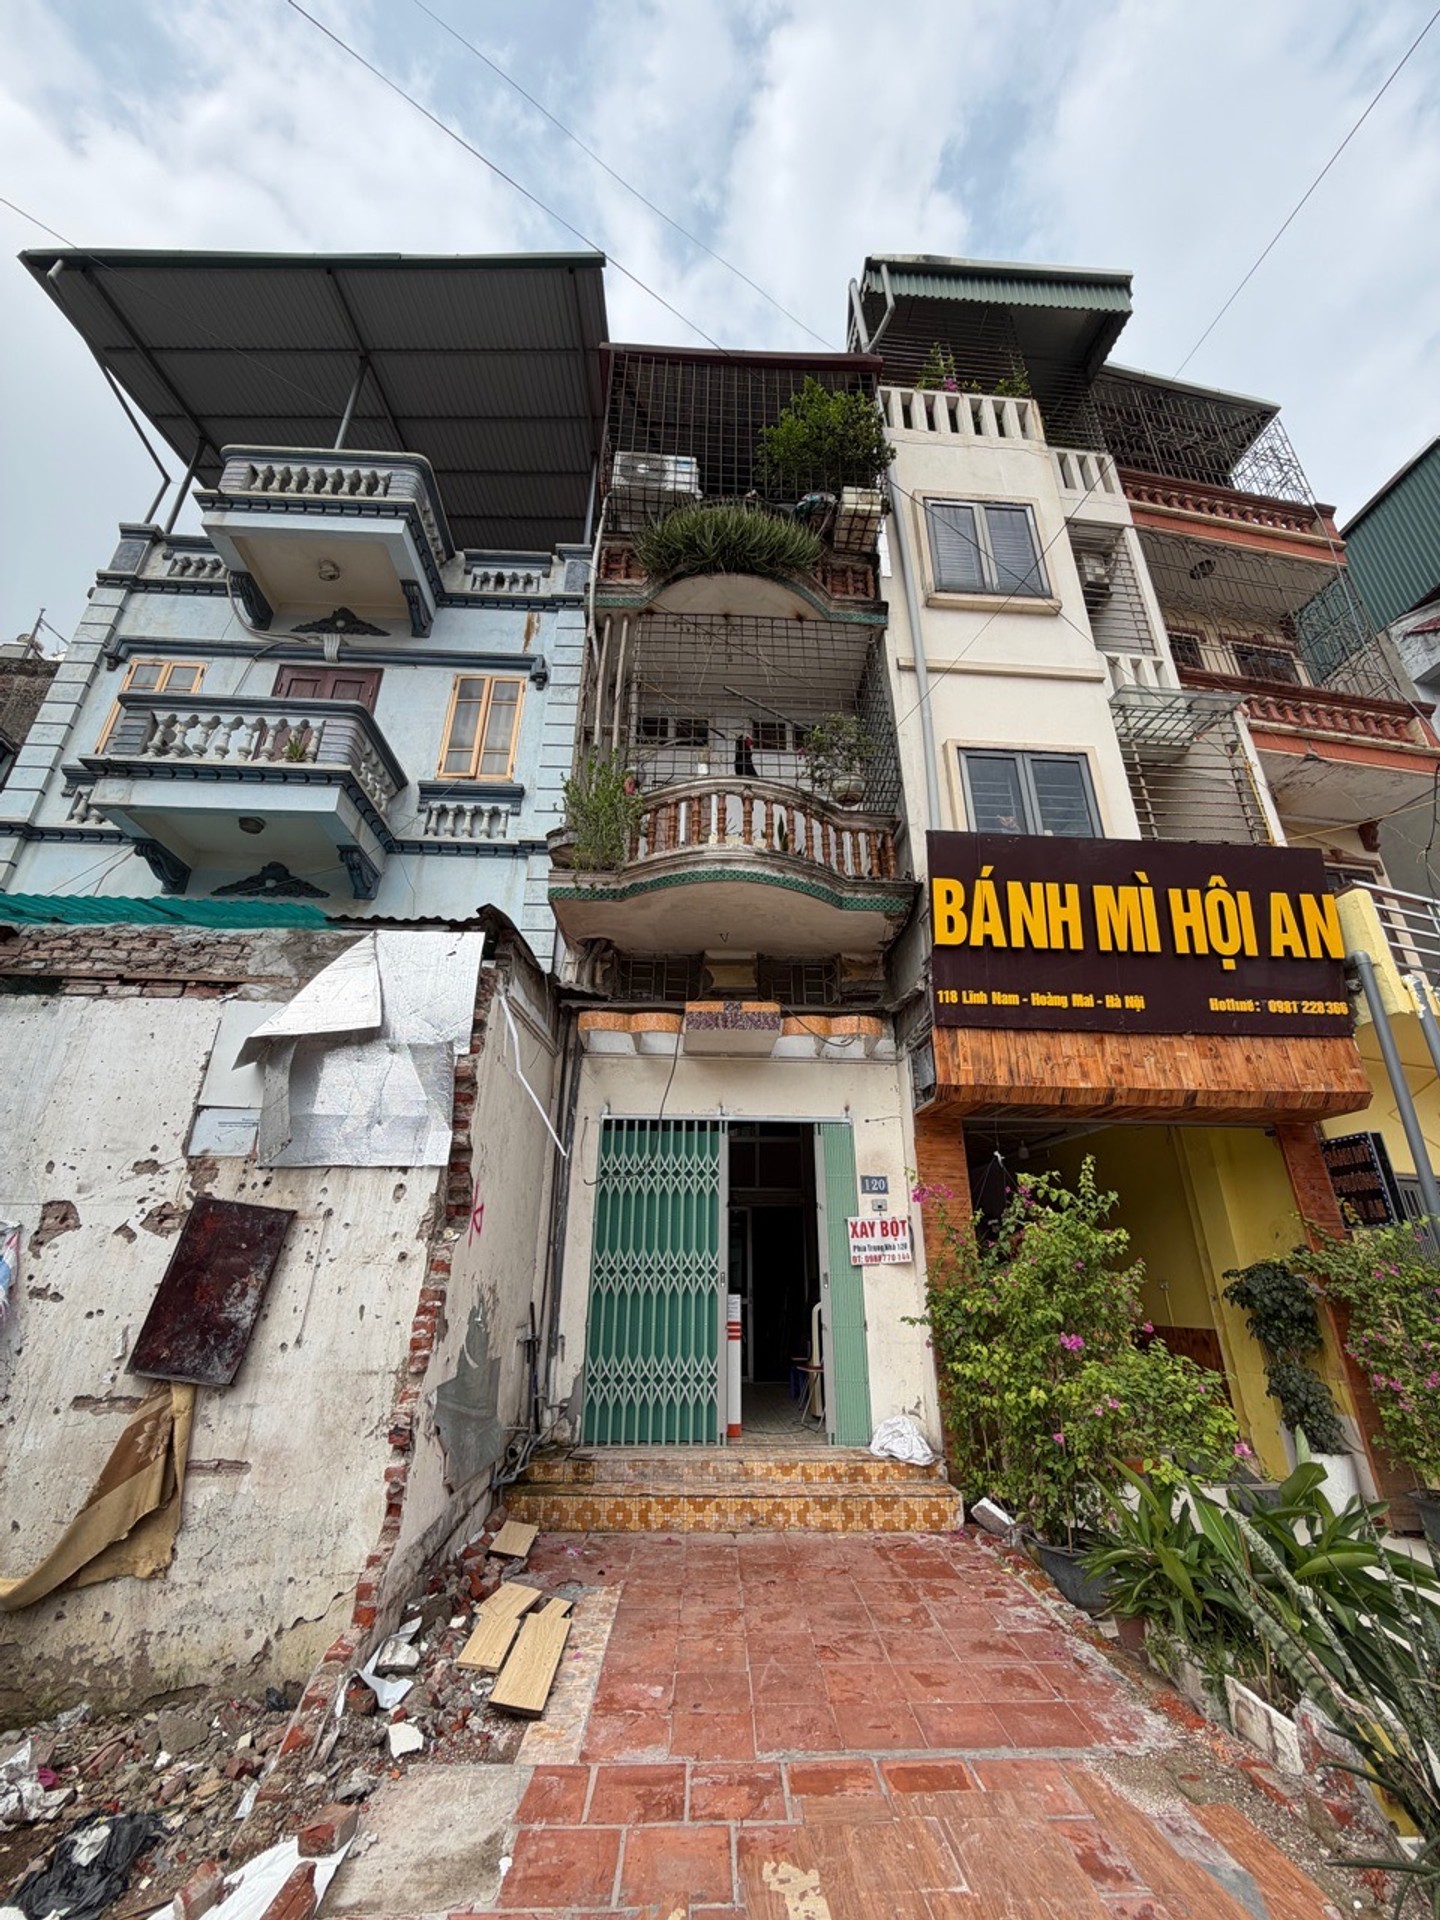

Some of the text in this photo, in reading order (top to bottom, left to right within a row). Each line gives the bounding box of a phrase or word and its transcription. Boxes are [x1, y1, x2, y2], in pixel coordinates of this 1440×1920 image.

[932, 865, 1345, 970] BÁNH MÌ HỘI AN
[936, 990, 958, 1004] 118
[991, 991, 1020, 1006] Nam
[1031, 991, 1069, 1009] Hoàng
[1071, 993, 1095, 1008] Mai
[1105, 994, 1122, 1009] Hà
[1124, 994, 1146, 1012] Nội
[864, 1179, 886, 1191] 120
[849, 1216, 907, 1241] XAY BỘT
